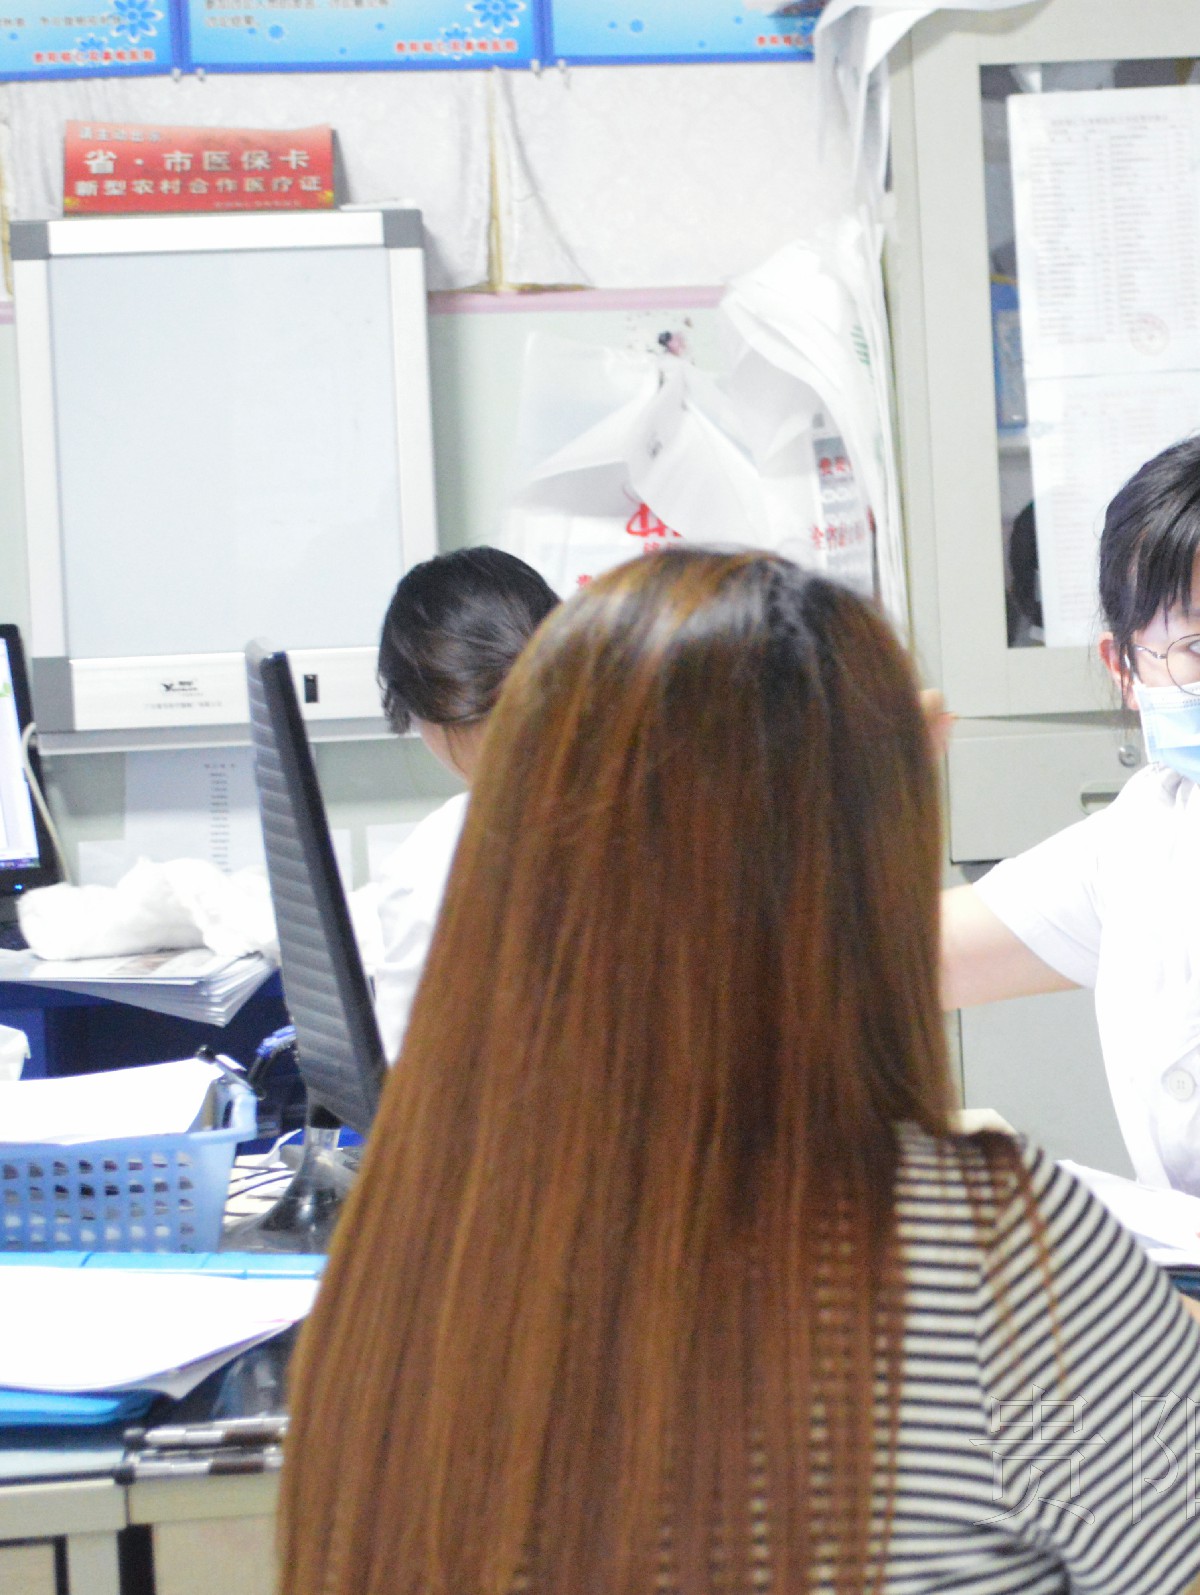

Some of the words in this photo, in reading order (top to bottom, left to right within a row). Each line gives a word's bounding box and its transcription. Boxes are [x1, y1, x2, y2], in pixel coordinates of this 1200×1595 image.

[84, 150, 311, 174] 省·市医保卡
[75, 176, 323, 196] 新型农村合作医疗证
